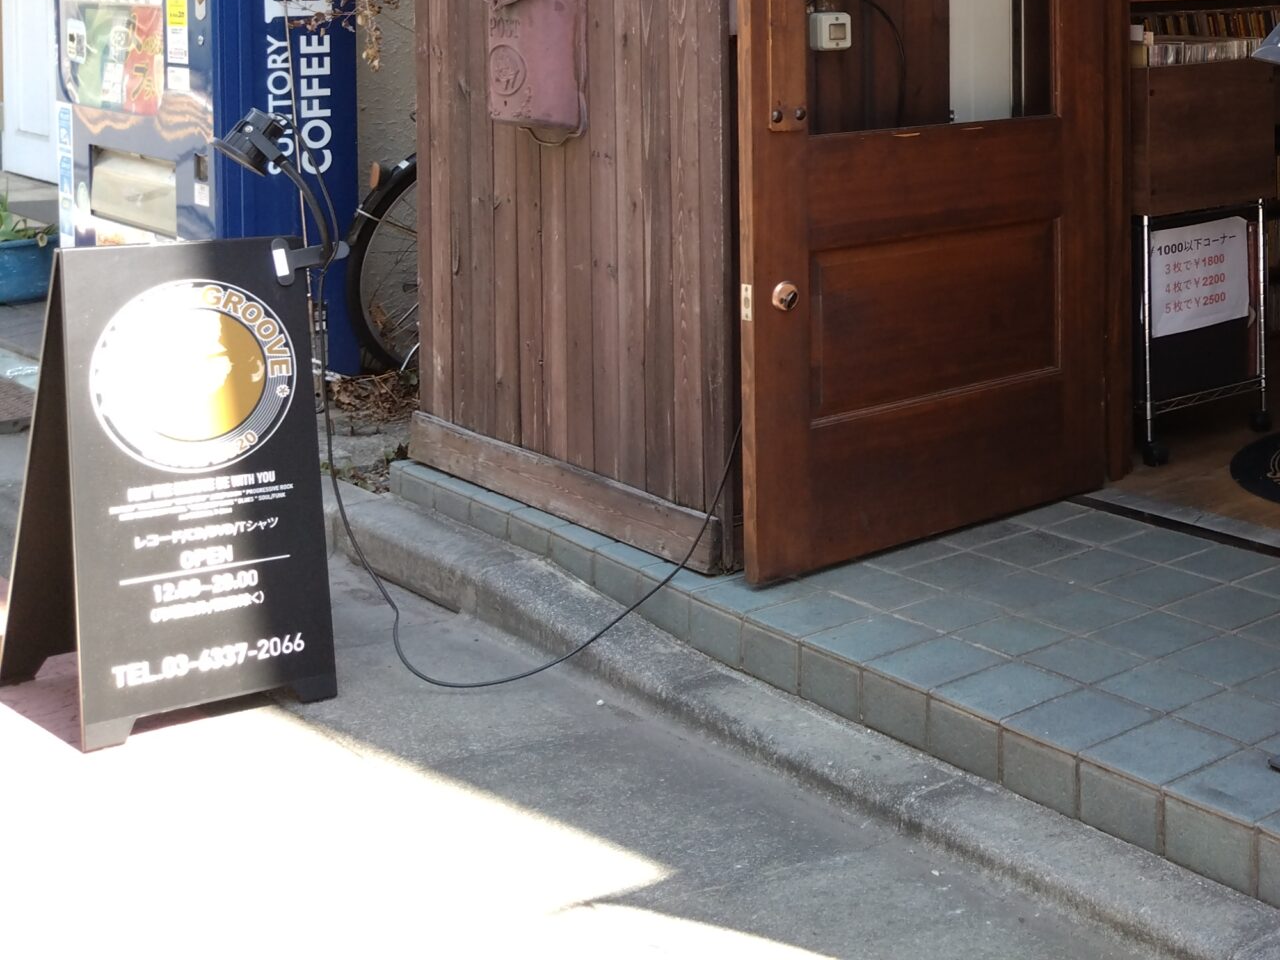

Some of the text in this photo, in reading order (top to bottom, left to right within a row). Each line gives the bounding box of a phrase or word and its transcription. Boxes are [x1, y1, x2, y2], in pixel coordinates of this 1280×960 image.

[299, 34, 333, 176] COFFEE
[201, 284, 292, 378] GROOVE
[256, 470, 276, 484] YOU
[179, 544, 234, 570] OPEN
